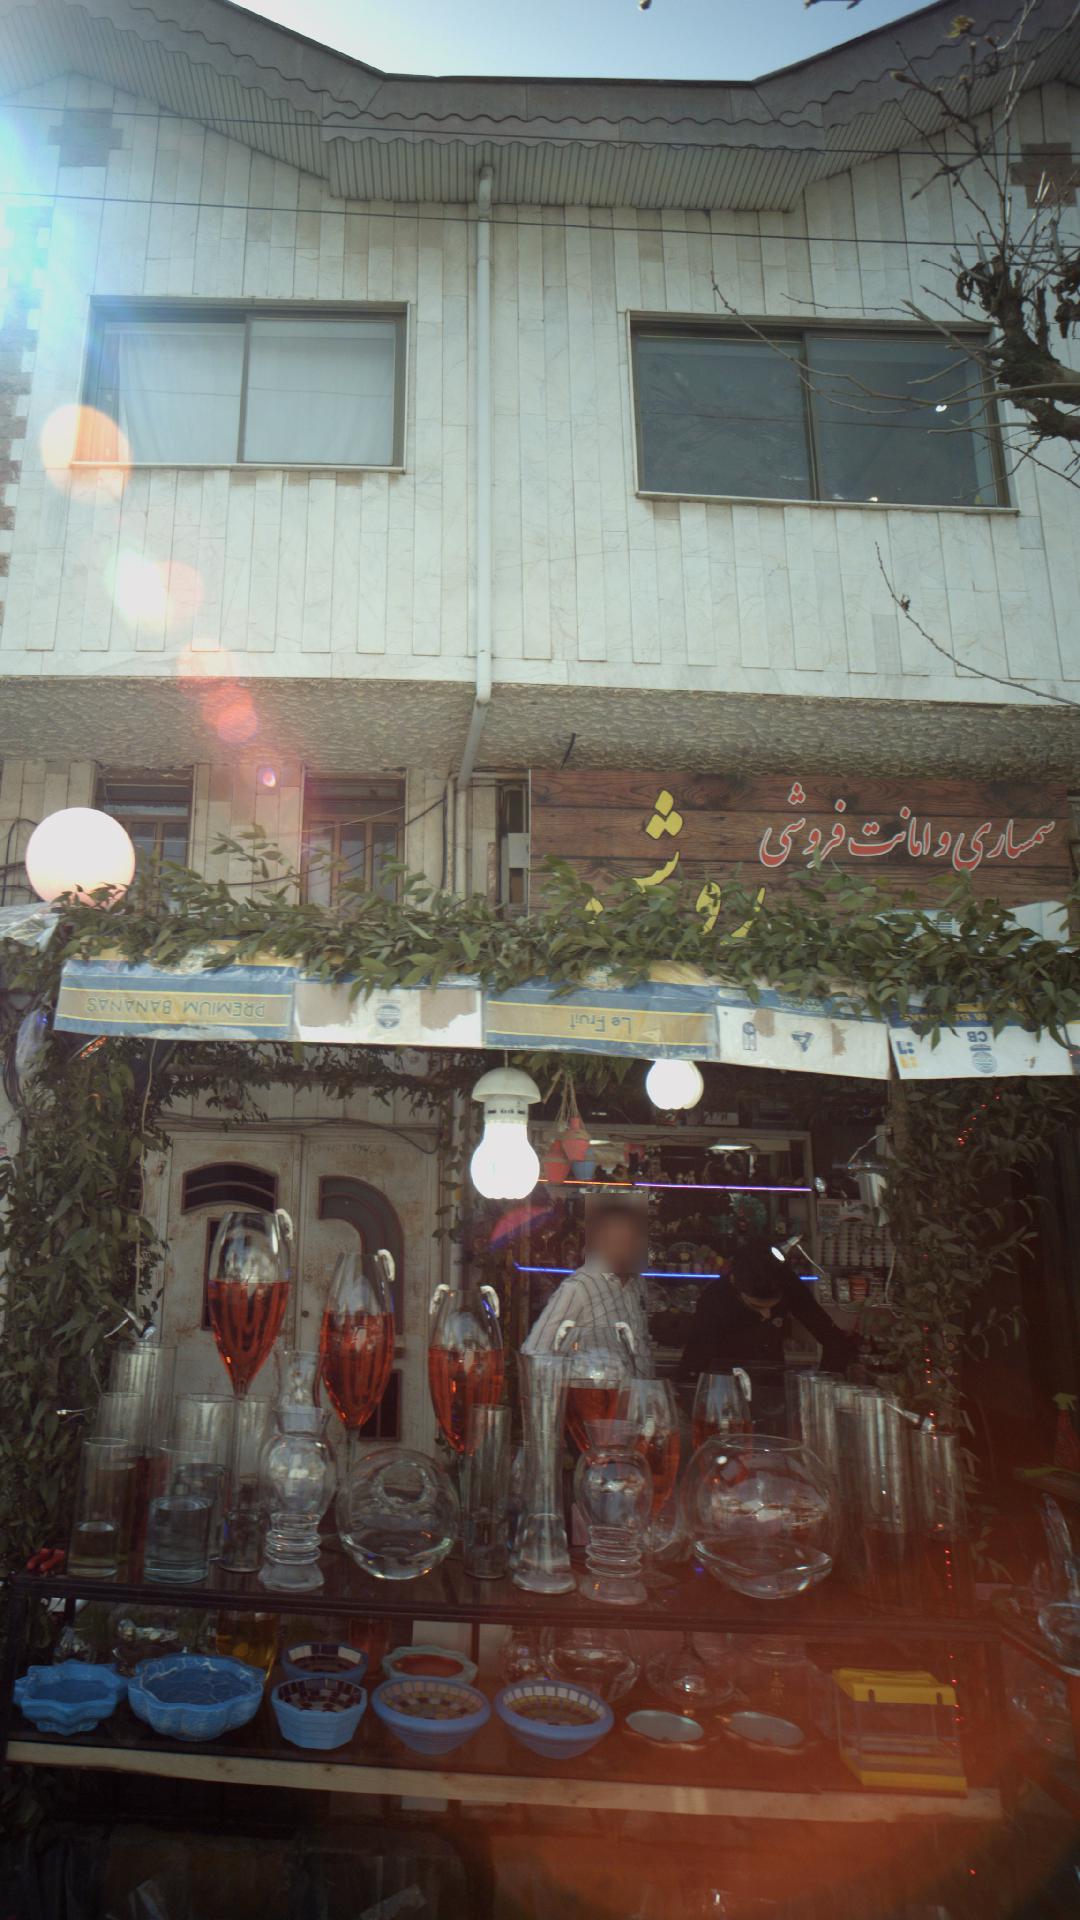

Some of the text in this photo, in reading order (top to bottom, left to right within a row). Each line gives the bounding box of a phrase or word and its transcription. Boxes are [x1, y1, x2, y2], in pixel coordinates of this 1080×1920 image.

[759, 782, 1056, 872] سمساری و امانت فروشی
[86, 997, 266, 1018] PREMIUM BANANAS
[569, 1014, 632, 1034] Le Fruit
